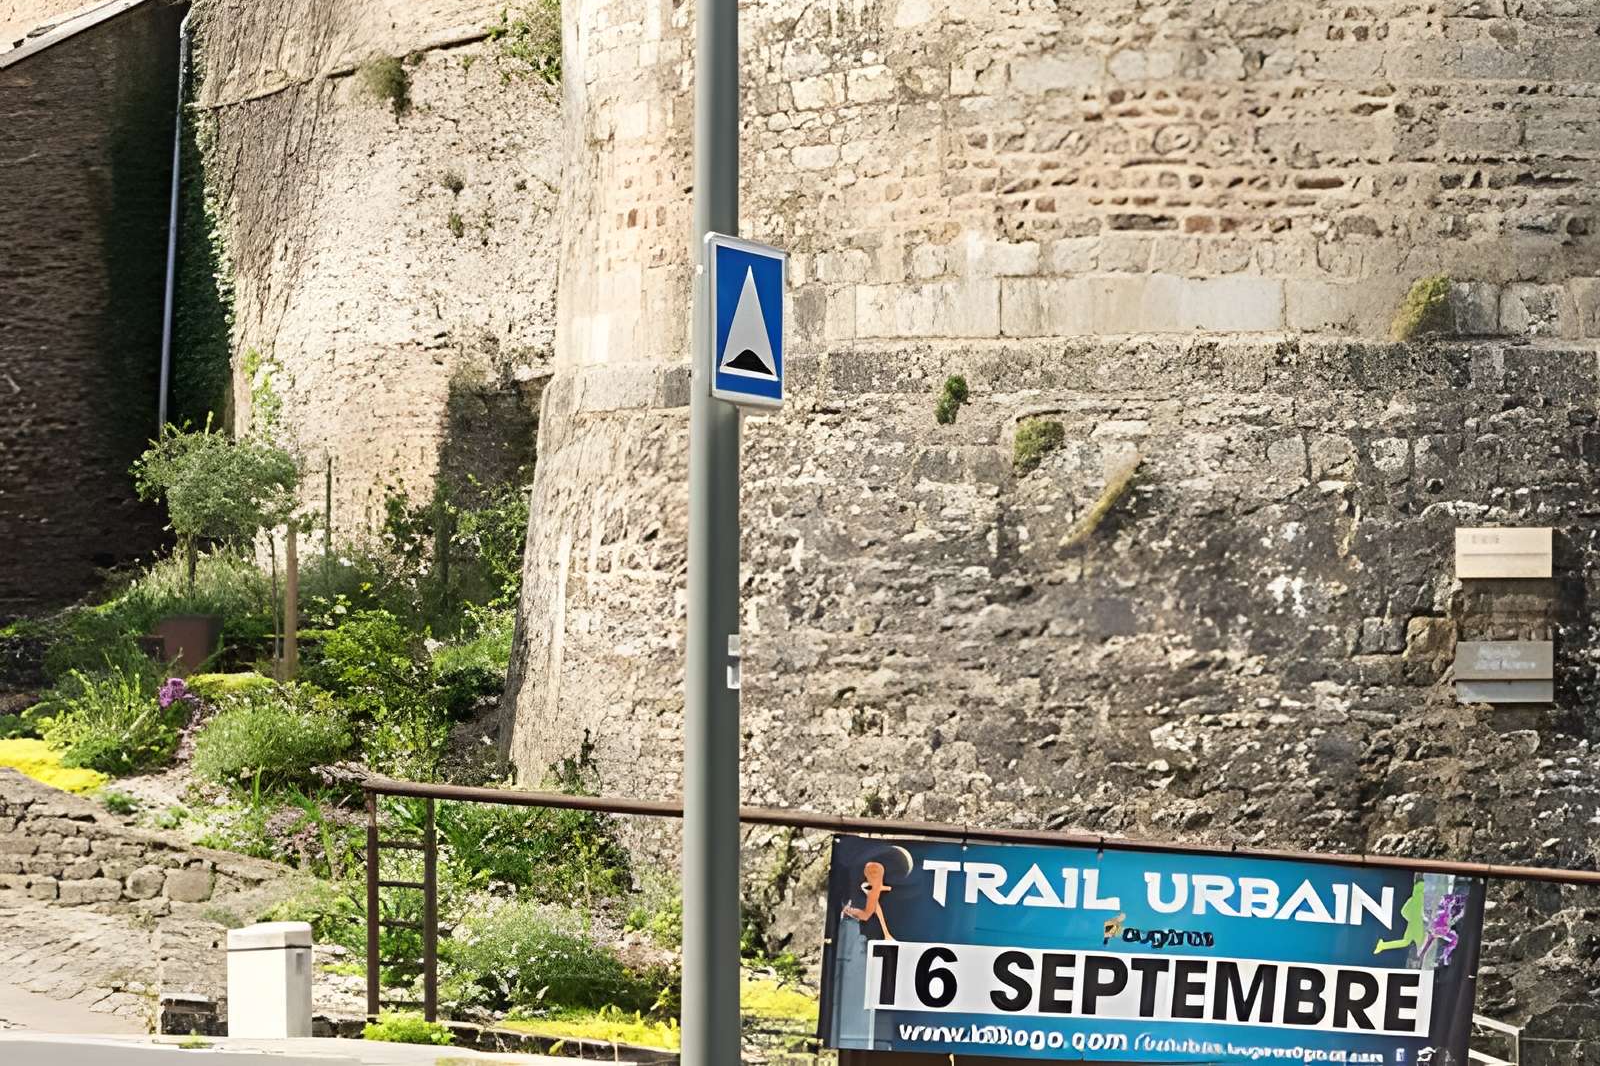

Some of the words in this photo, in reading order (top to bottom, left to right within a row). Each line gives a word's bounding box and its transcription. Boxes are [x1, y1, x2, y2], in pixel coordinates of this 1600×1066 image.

[922, 859, 1121, 911] TRAIL
[1145, 871, 1395, 930] URBAIN
[872, 944, 959, 1008] 16
[989, 950, 1421, 1032] SEPTEMBRE
